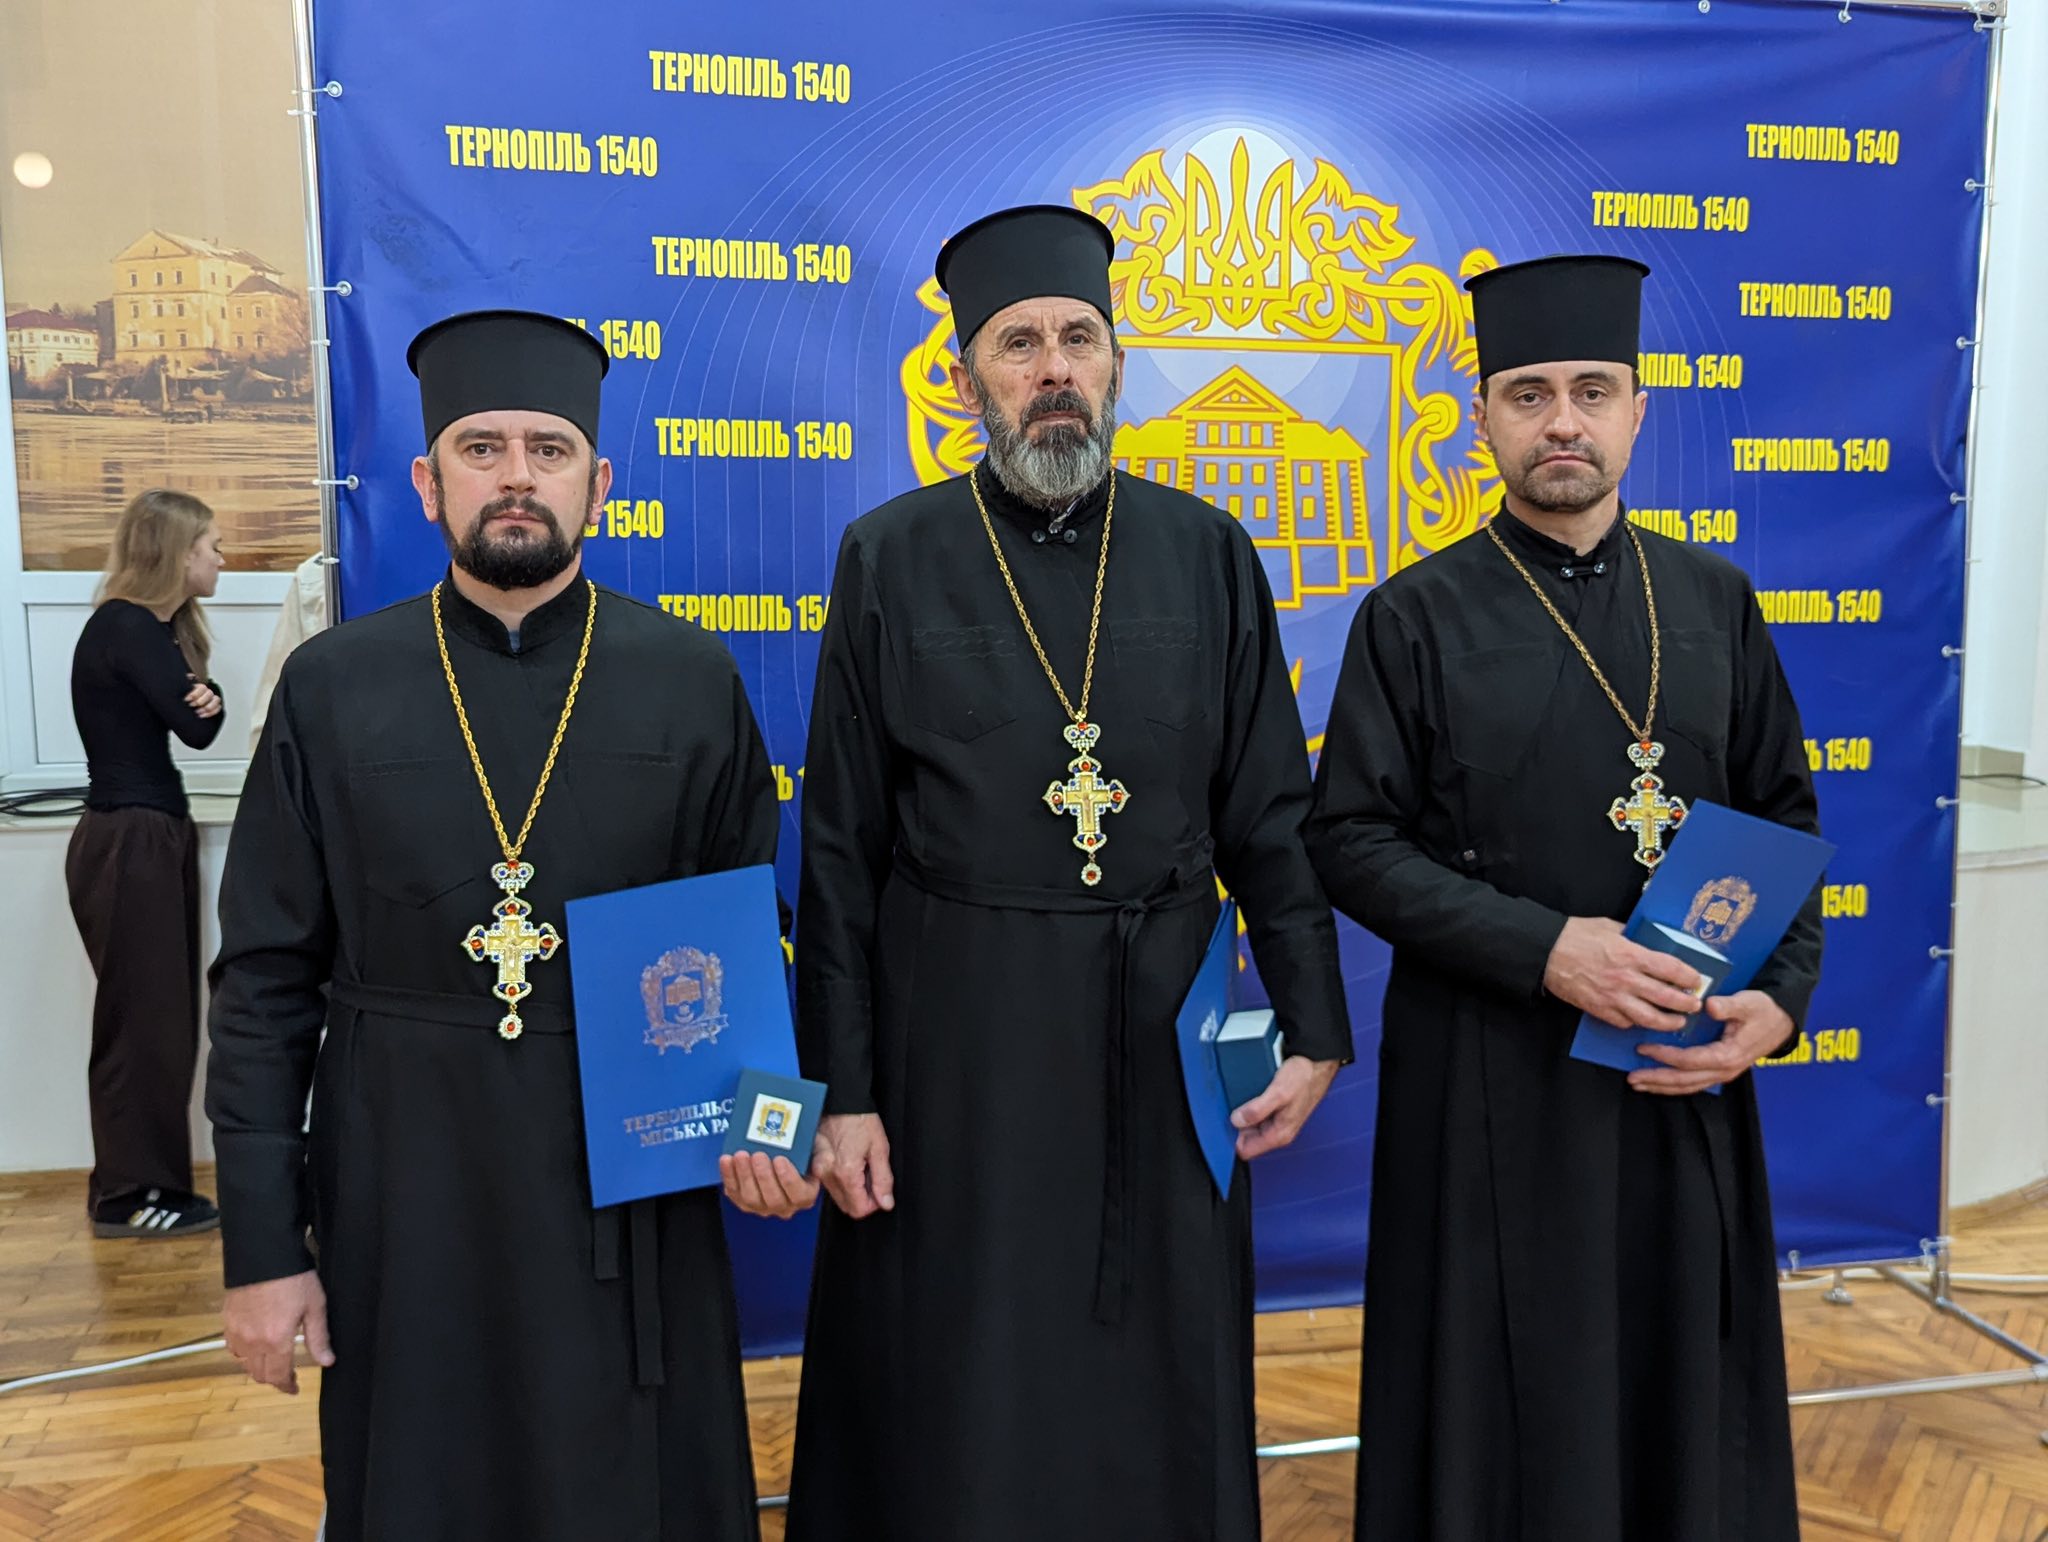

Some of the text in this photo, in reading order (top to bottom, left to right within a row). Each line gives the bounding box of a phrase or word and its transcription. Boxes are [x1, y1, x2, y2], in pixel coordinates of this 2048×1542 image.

[649, 51, 850, 103] ТЕРНОПІЛЬ 1540
[445, 125, 658, 177] ТЕРНОПІЛЬ 1540
[1747, 124, 1899, 165] ТЕРНОПІЛЬ 1540
[1592, 191, 1749, 232] ТЕРНОПІЛЬ 1540
[652, 236, 851, 284] ТЕРНОПІЛЬ 1540
[1739, 283, 1891, 320] ТЕРНОПІЛЬ 1540
[600, 320, 661, 360] 1540
[1696, 354, 1742, 389] 1540
[655, 418, 852, 460] ТЕРНОПІЛЬ 1540
[1732, 439, 1889, 472] ТЕРНОПІЛЬ 1540
[603, 500, 664, 538] 1540
[1689, 509, 1738, 543] 1540
[796, 595, 831, 632] 15
[1755, 589, 1881, 623] НОПІЛЬ 1540
[1824, 738, 1871, 771] 1540
[1822, 884, 1867, 918] 1540
[1814, 1028, 1860, 1063] 1540
[624, 1098, 735, 1134] ТЕРНОПІЛЬС
[711, 1117, 730, 1134] РА
